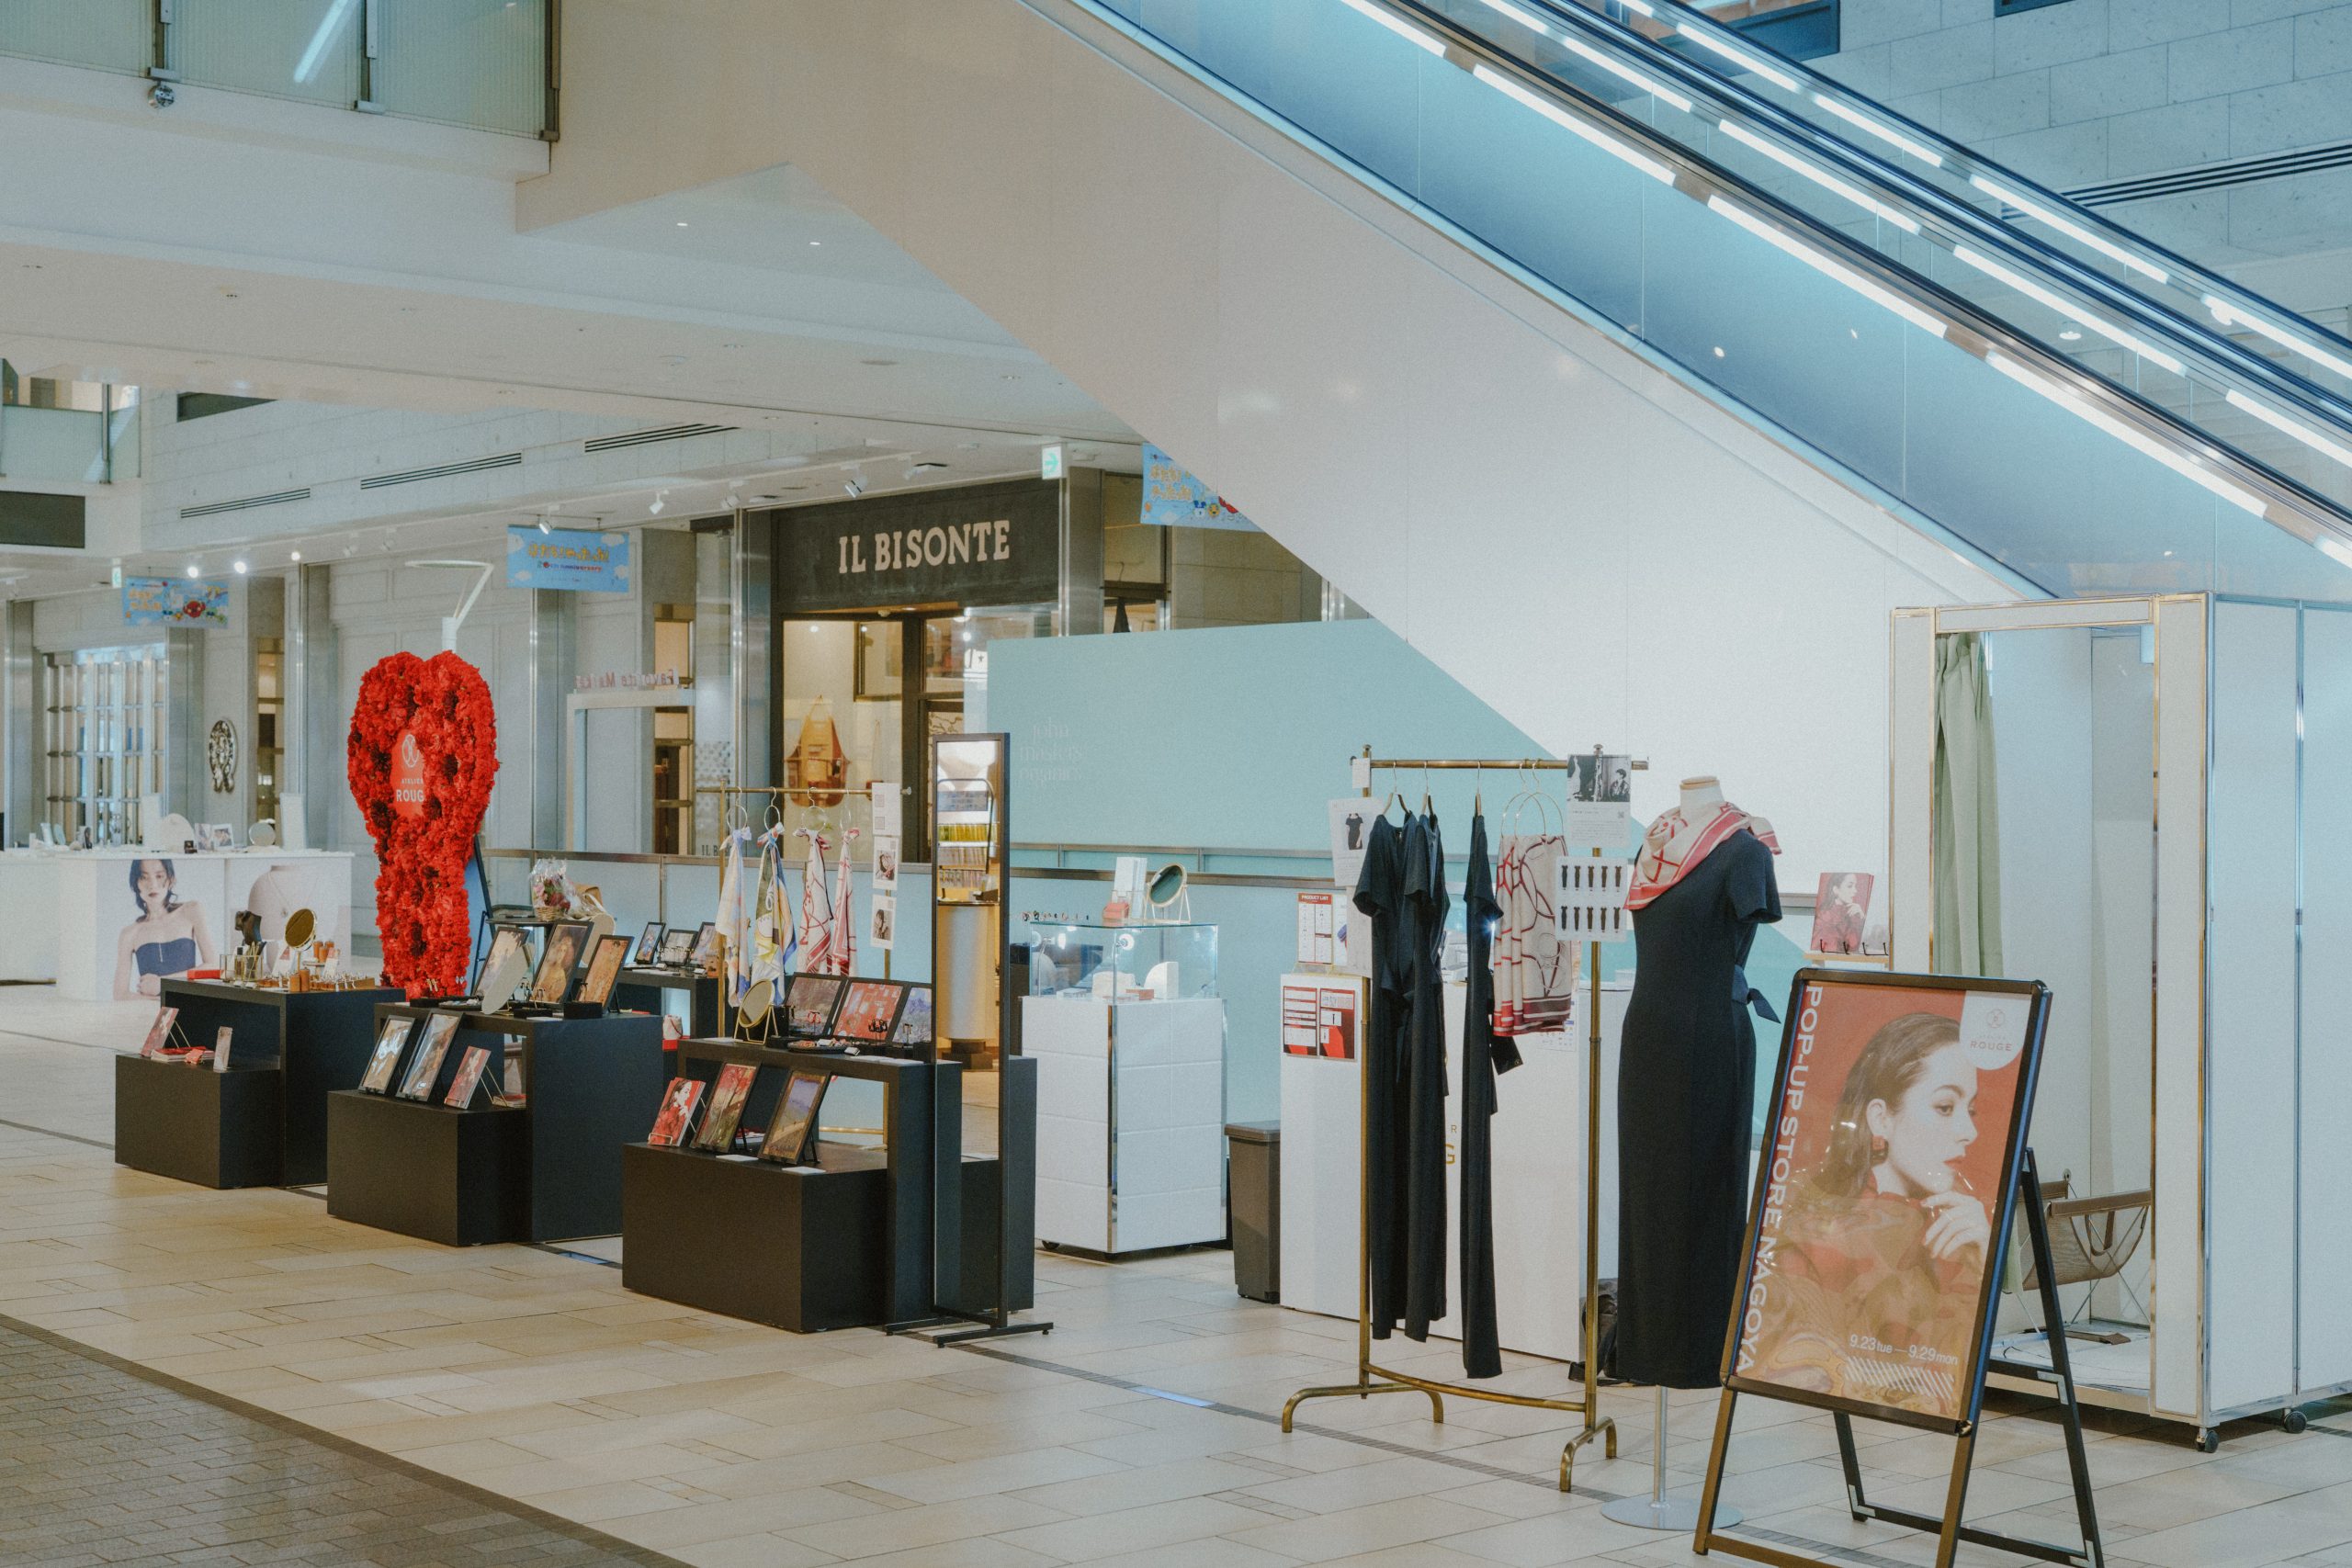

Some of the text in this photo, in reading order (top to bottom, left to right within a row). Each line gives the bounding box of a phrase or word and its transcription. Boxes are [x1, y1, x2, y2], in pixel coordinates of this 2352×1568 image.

[839, 520, 1010, 574] IL BISONTE
[396, 789, 424, 802] ROUG
[1970, 1041, 2012, 1052] ROUGE
[1736, 986, 1823, 1373] POP-UP STORE NAGOYA
